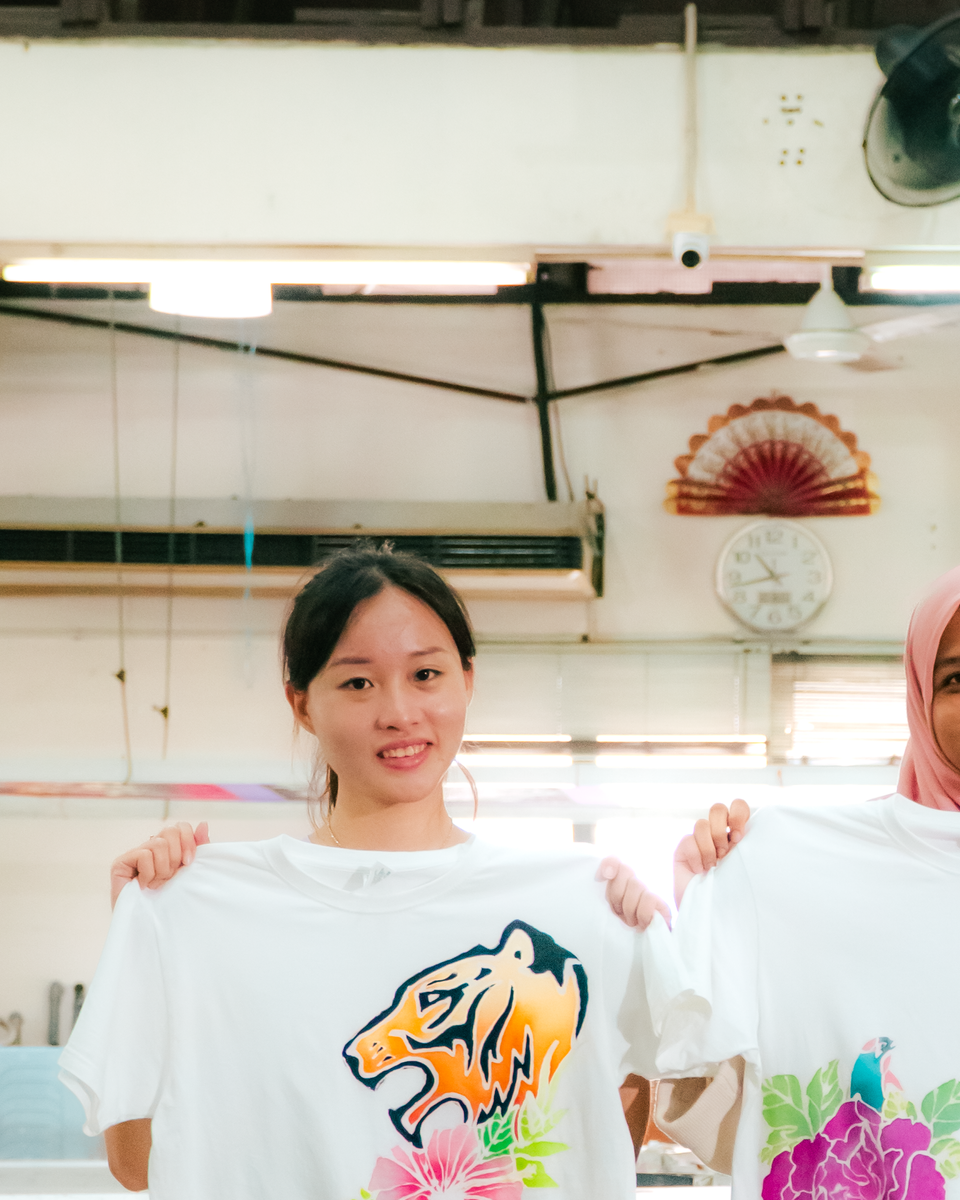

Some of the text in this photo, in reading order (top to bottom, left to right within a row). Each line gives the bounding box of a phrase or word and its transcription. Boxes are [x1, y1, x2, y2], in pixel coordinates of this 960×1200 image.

[765, 529, 784, 544] 12
[792, 534, 799, 549] 1
[734, 551, 751, 565] 10
[801, 550, 818, 565] 2
